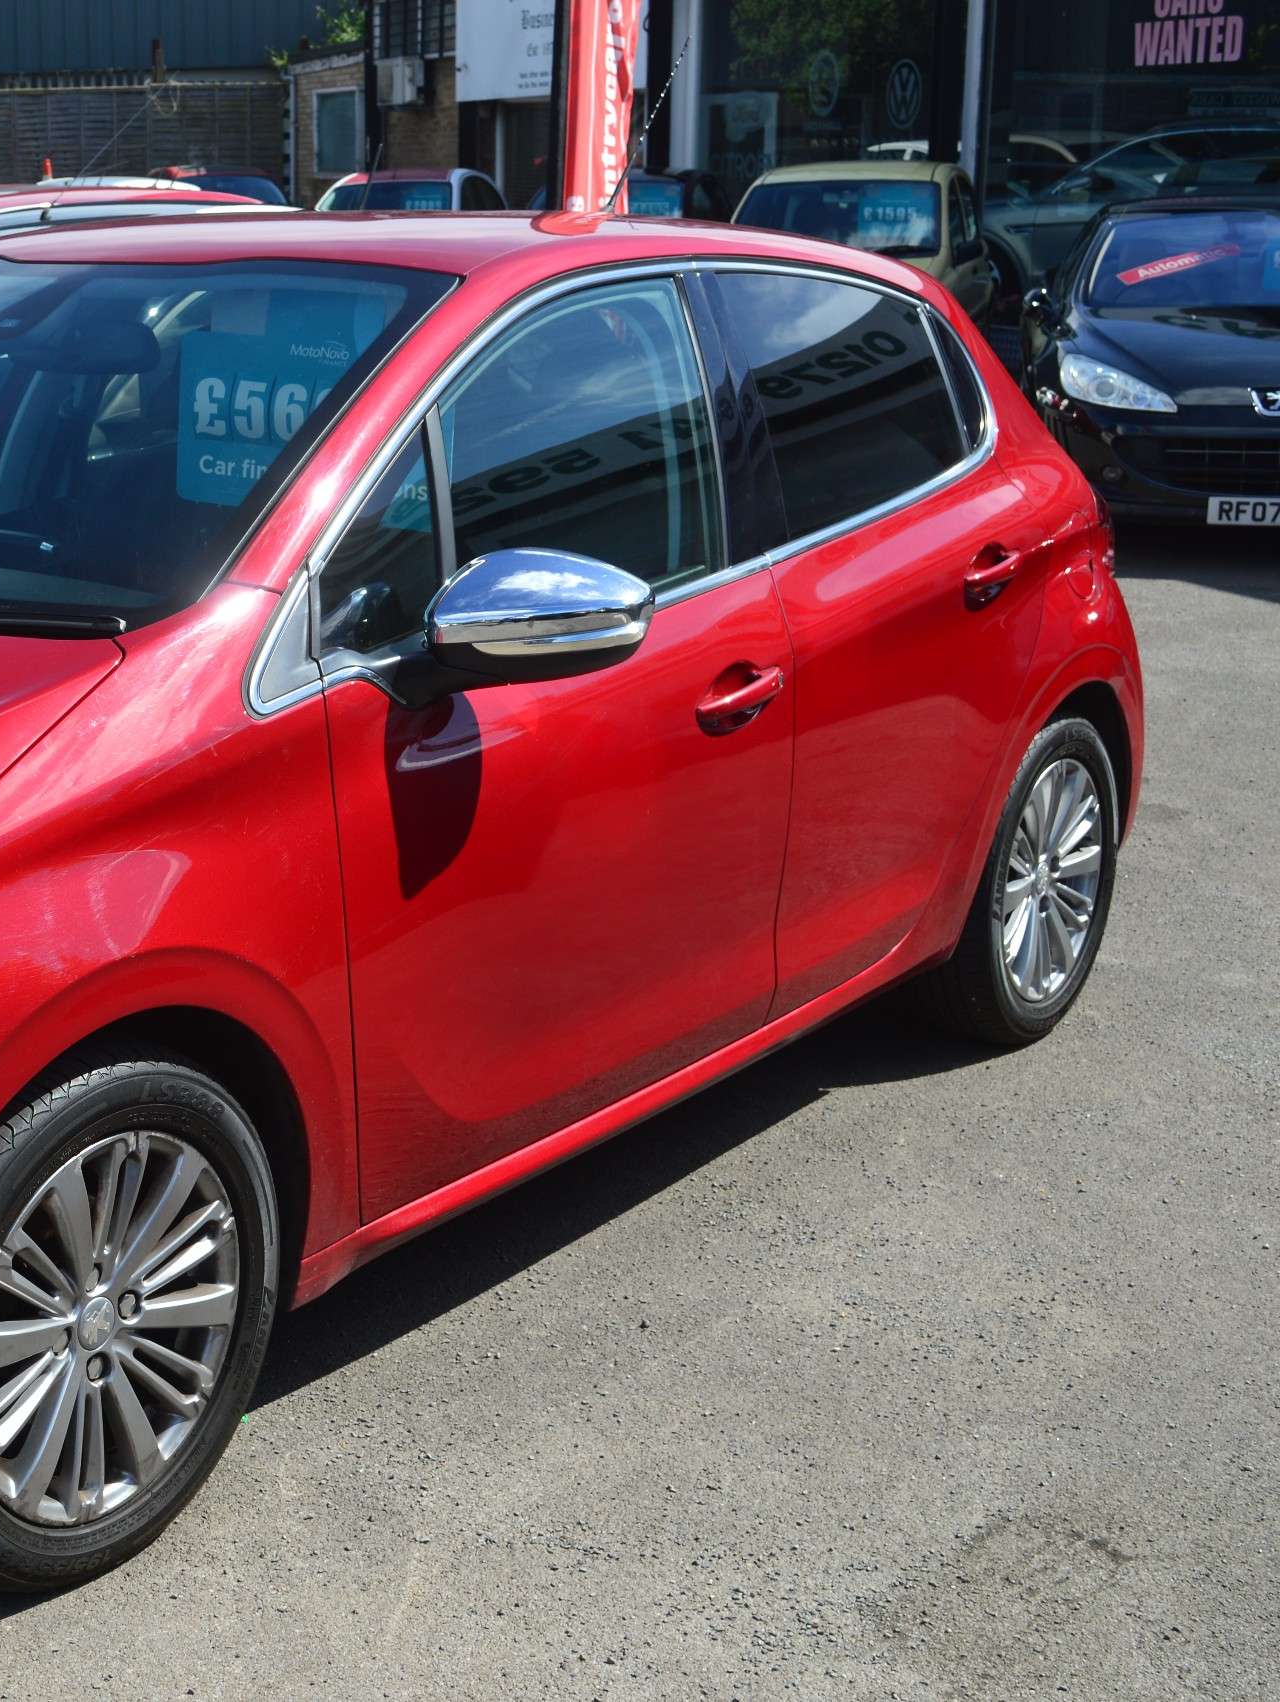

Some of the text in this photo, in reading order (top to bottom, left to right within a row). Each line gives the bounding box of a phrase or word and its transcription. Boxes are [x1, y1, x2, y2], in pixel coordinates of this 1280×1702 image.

[1134, 16, 1244, 67] WANTED
[1137, 248, 1226, 279] Automatic
[289, 343, 350, 361] MotoNovo
[199, 454, 234, 476] Car
[1218, 500, 1280, 522] RF07
